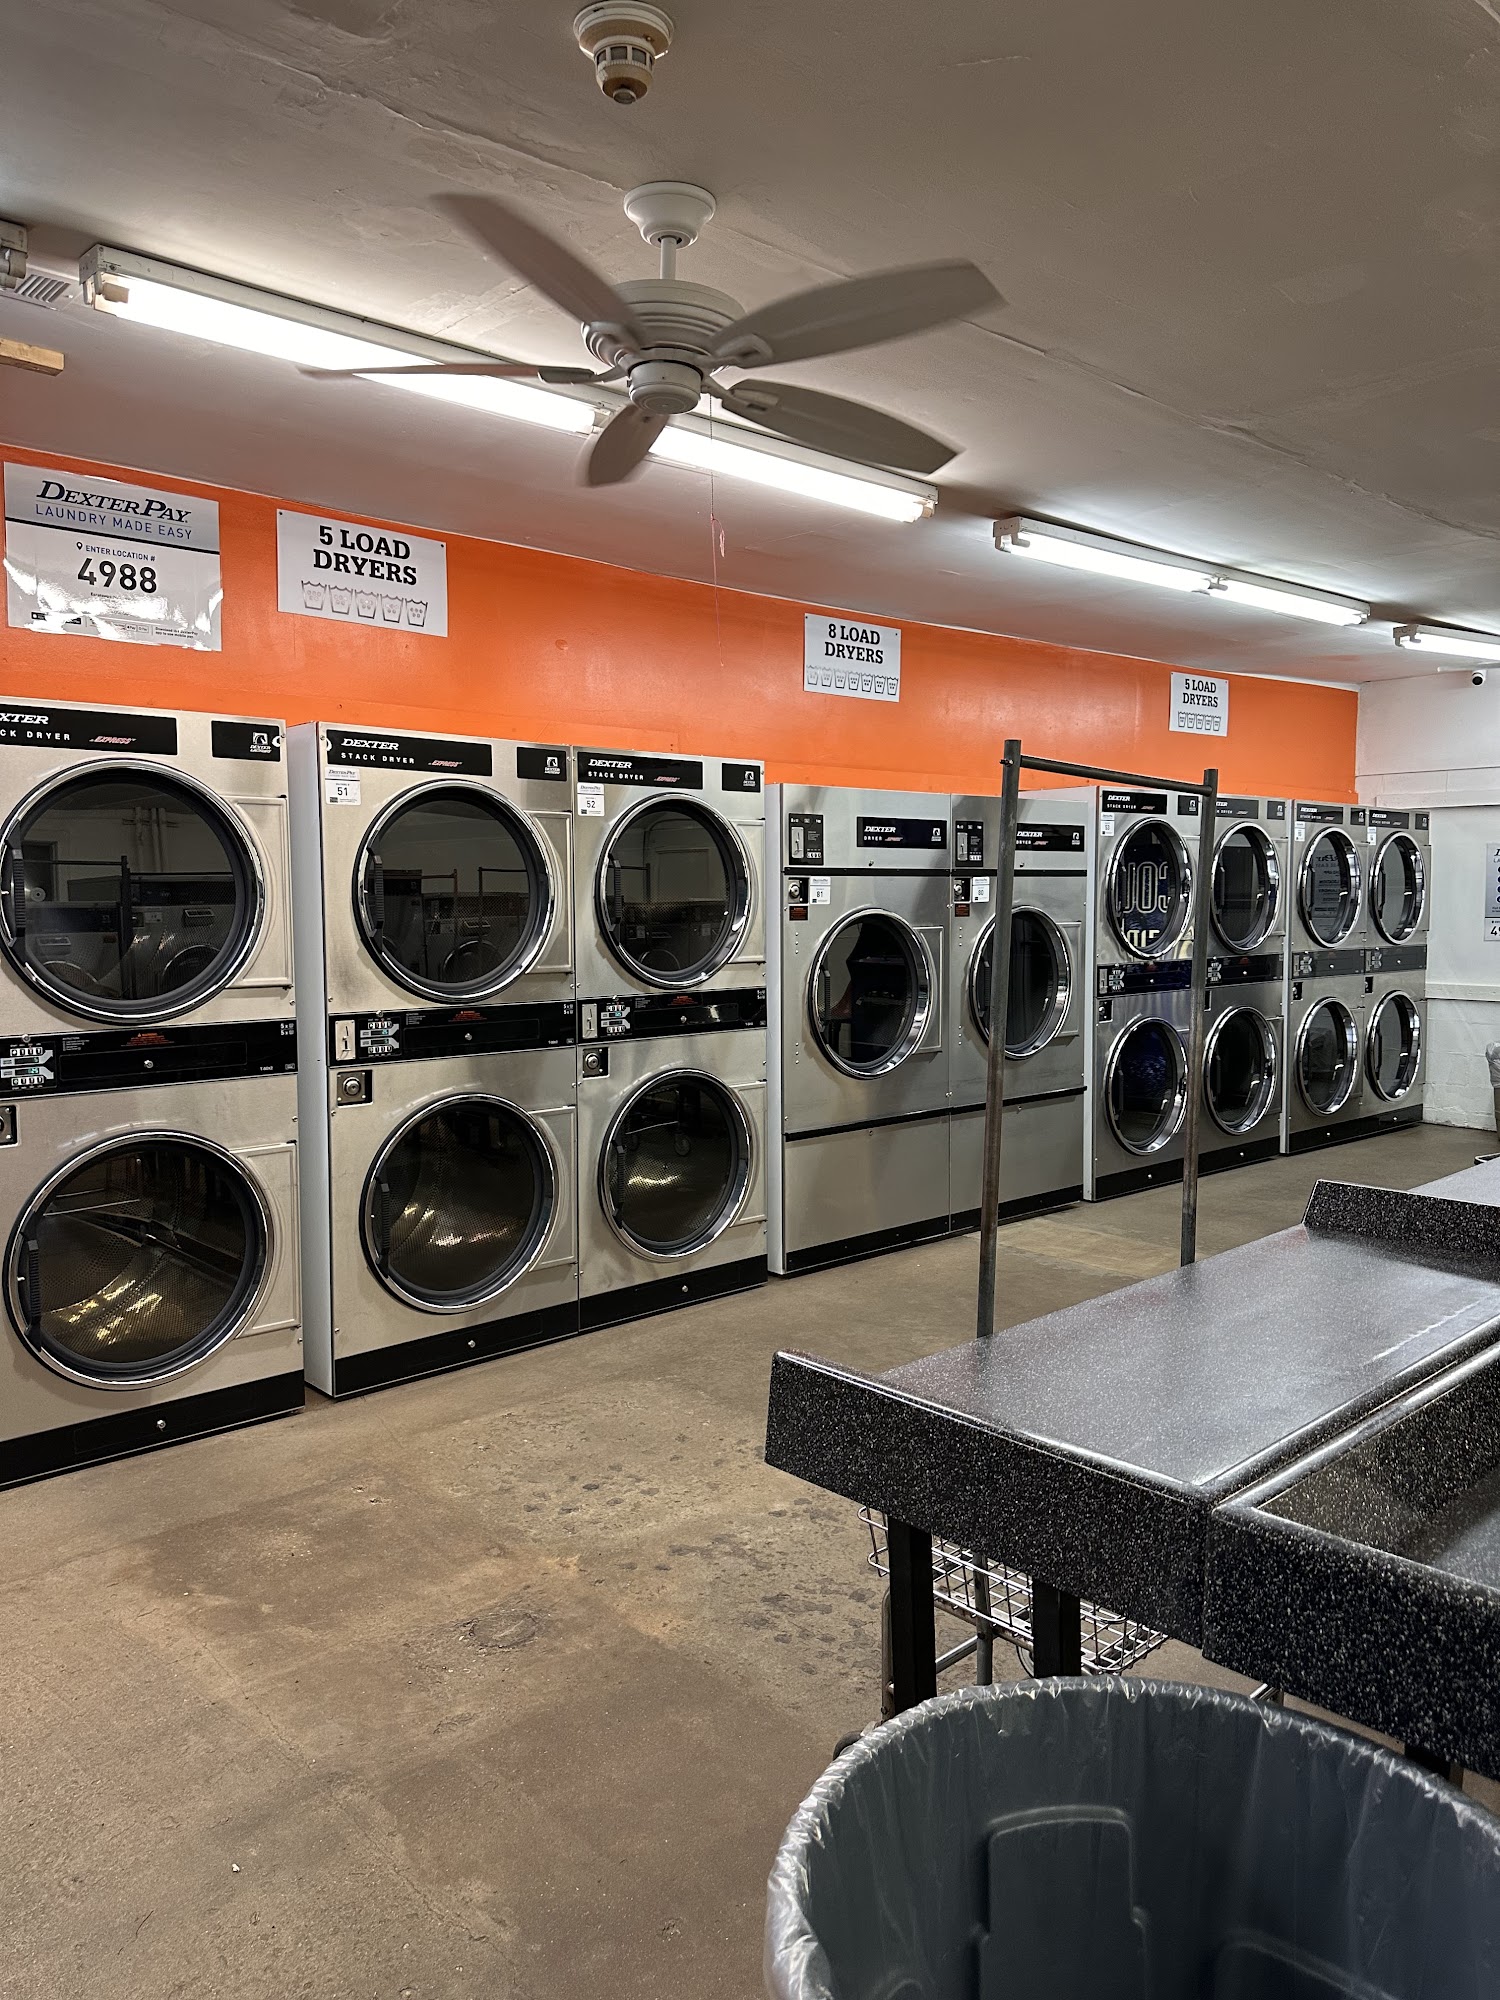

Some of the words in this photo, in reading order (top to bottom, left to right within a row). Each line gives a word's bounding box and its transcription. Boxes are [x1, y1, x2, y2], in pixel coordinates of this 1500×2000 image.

[35, 504, 107, 525] LAUNDRY
[113, 516, 152, 534] MADE
[158, 524, 192, 540] EASY
[319, 525, 333, 546] 5
[340, 529, 411, 560] LOAD
[85, 545, 111, 556] ENTER
[112, 549, 149, 562] LOCATION
[313, 548, 417, 586] DRYERS
[77, 557, 157, 594] 4988
[828, 623, 836, 639] 8
[840, 625, 880, 645] LOAD
[825, 641, 884, 664] DRYERS
[1185, 678, 1190, 690] 5
[1192, 679, 1217, 693] LOAD
[1182, 692, 1219, 708] DRYERS
[26, 731, 70, 741] DRYER
[341, 738, 399, 751] DEXTER
[341, 752, 376, 761] STACK
[382, 755, 415, 764] DRYER
[588, 759, 633, 769] DEXTER
[588, 771, 615, 779] STACK
[619, 773, 644, 781] DRYER
[337, 786, 348, 797] 51
[586, 800, 596, 809] 52
[864, 825, 896, 833] DEXTER
